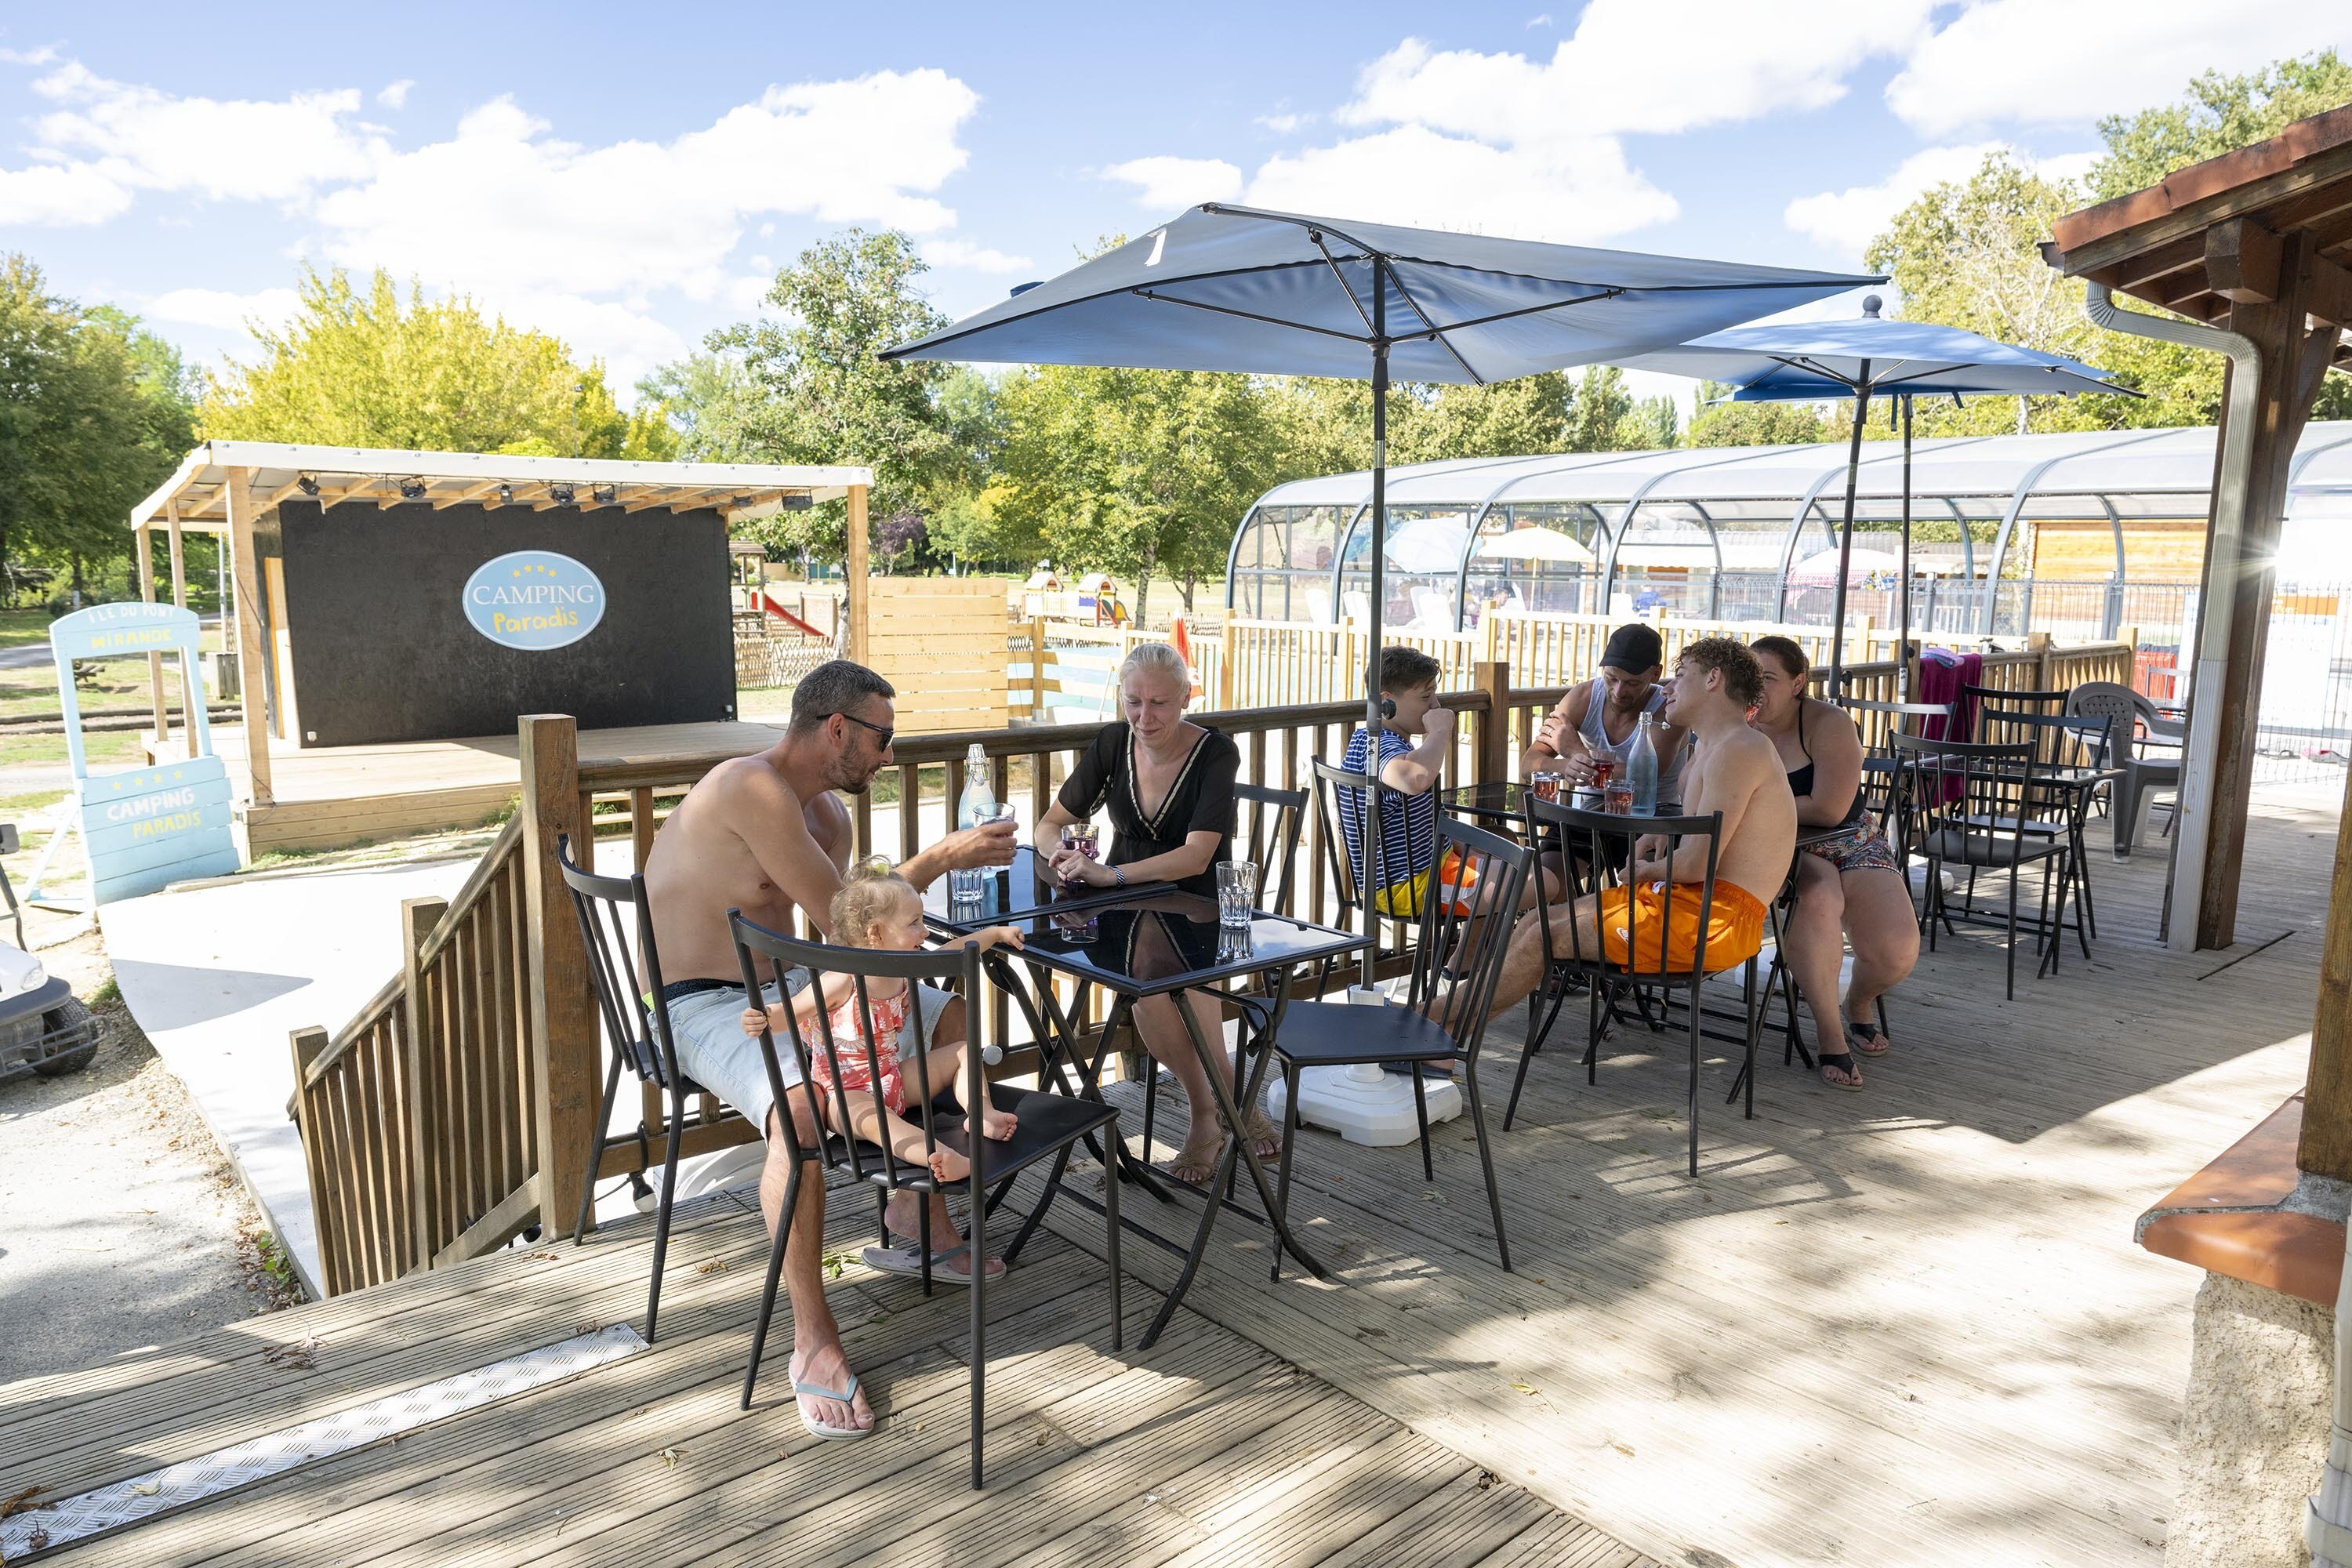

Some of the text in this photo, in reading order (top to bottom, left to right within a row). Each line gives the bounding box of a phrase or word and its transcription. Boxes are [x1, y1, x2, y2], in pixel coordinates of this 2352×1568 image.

[472, 584, 594, 605] CAMPING
[121, 605, 138, 618] DU
[143, 604, 176, 618] PONT
[492, 606, 578, 633] Paradis
